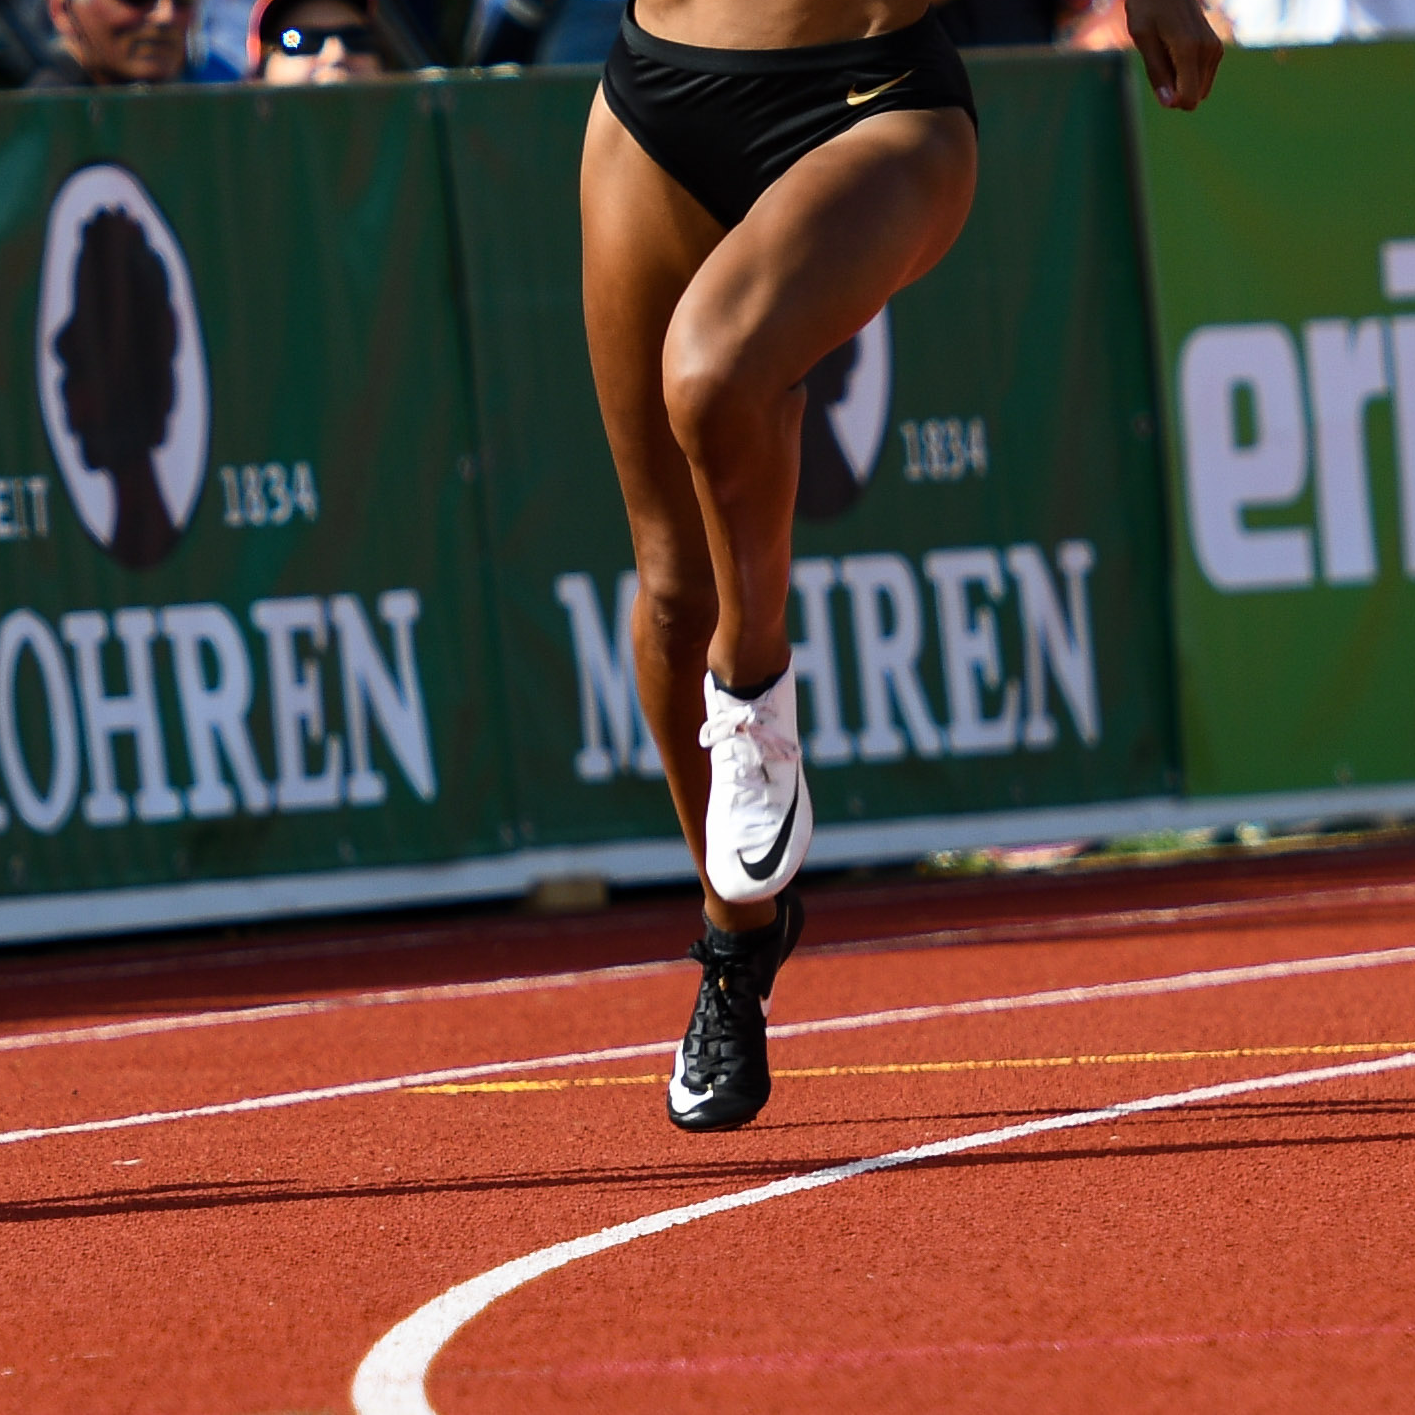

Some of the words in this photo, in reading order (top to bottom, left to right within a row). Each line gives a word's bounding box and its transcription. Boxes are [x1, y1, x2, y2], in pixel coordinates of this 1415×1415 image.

[900, 417, 987, 482] 1834
[217, 461, 318, 527] 1834
[555, 540, 1099, 780] MHREN
